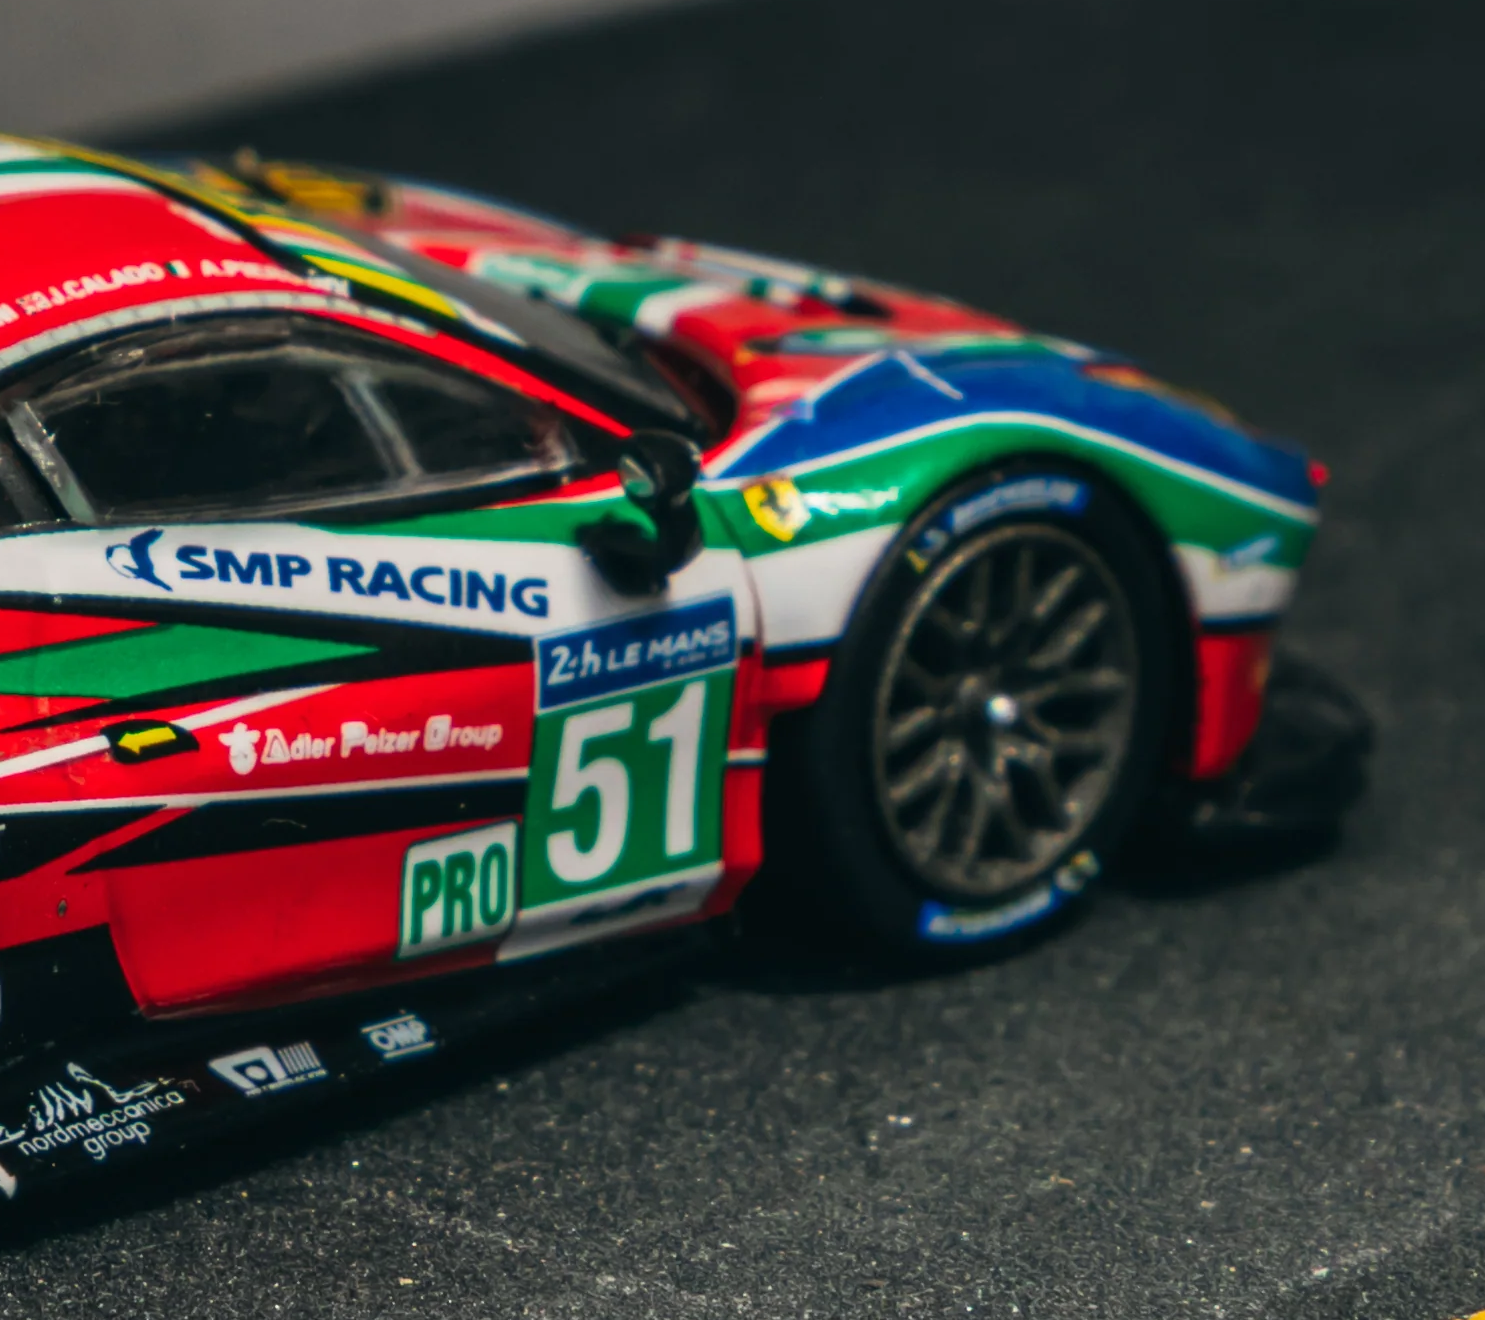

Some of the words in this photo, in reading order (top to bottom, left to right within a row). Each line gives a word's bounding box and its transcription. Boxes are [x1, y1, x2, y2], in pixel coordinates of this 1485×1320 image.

[175, 545, 311, 588] SMP
[326, 556, 550, 618] RACING
[607, 643, 642, 671] LE
[646, 620, 729, 663] MANS
[261, 727, 336, 765] Adler
[340, 720, 418, 759] Pelzer
[425, 714, 503, 752] Group
[546, 680, 707, 885] 51
[408, 841, 509, 947] PRO
[16, 1088, 185, 1156] nordmeccanica
[83, 1118, 151, 1161] group
